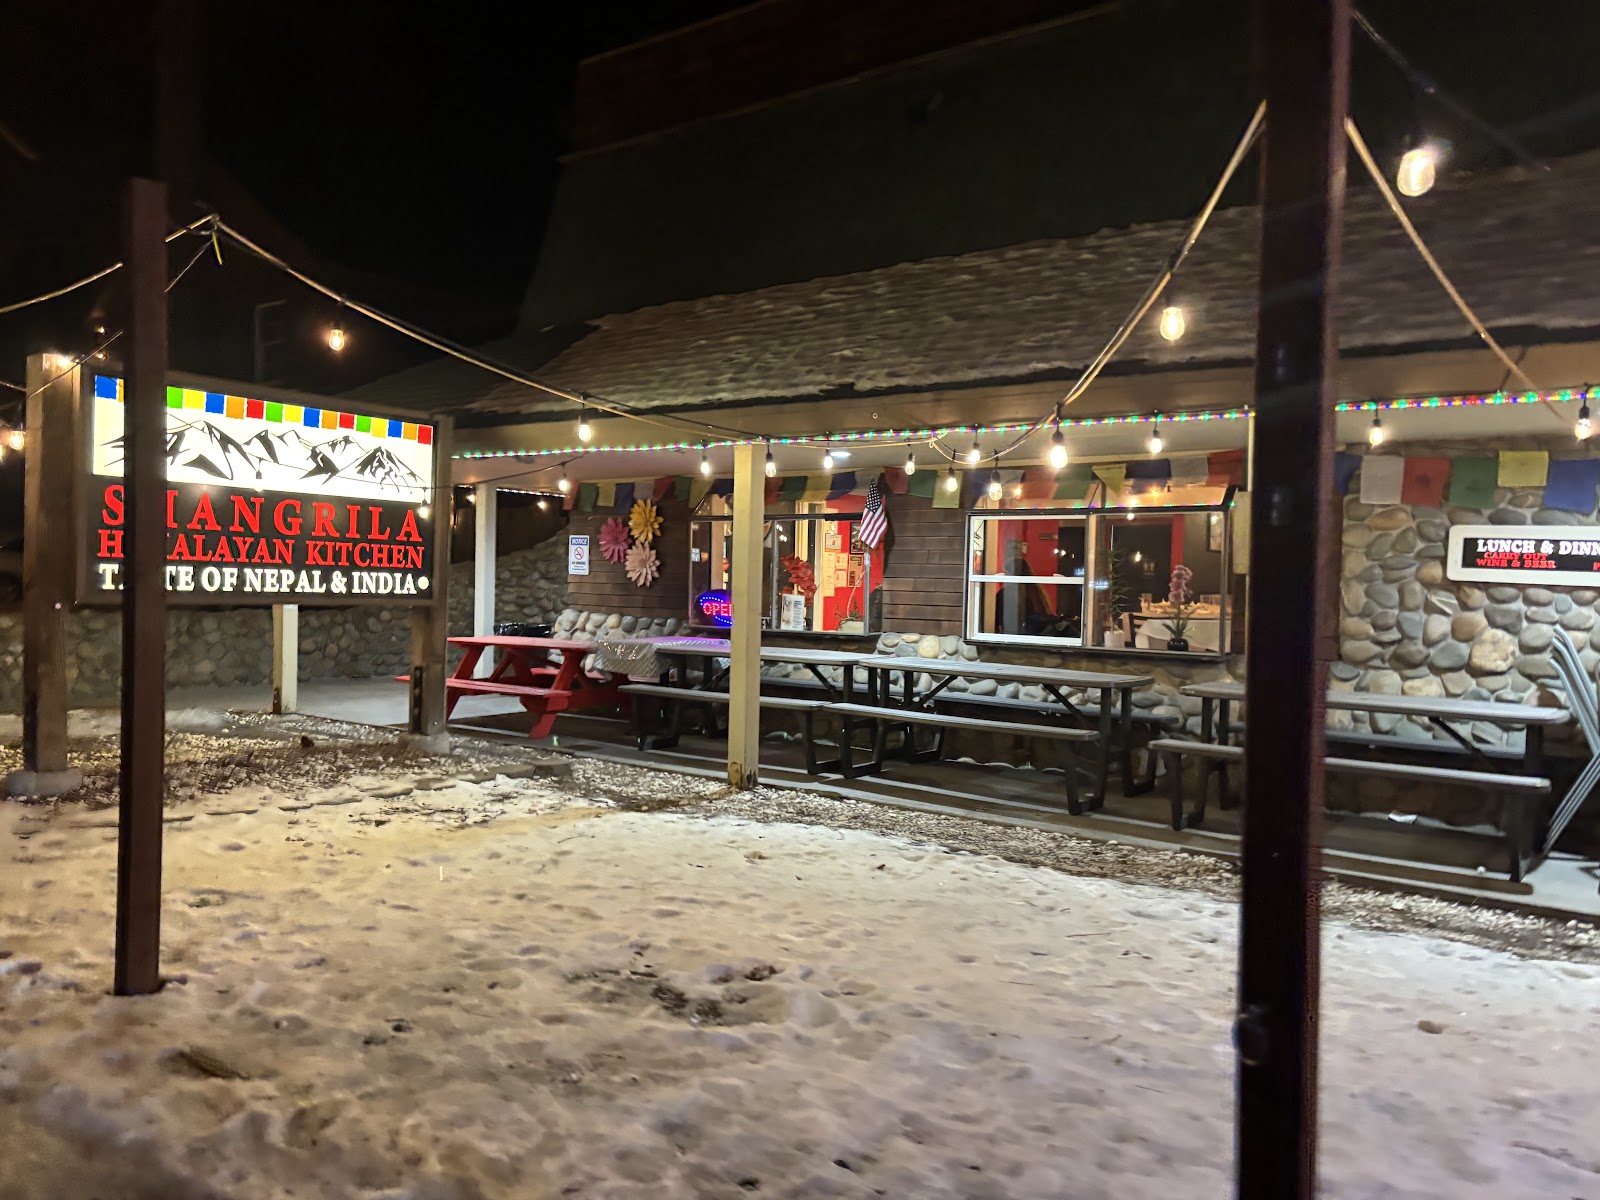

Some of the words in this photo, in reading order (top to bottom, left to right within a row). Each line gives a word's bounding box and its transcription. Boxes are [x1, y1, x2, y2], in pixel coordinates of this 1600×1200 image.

[97, 529, 295, 564] HALAYAN
[306, 540, 425, 569] KITCHEN
[1477, 539, 1536, 553] LUNCH
[1540, 540, 1554, 554] &
[1476, 558, 1508, 567] WINE
[1511, 560, 1521, 568] &
[1524, 560, 1556, 568] BEER
[1484, 552, 1521, 560] CARRY
[1523, 552, 1549, 561] OUT
[99, 564, 194, 591] TTE
[201, 566, 237, 592] OF
[243, 568, 327, 594] NEPAL
[330, 571, 347, 594] &
[352, 571, 418, 595] INDIA
[703, 602, 732, 617] OPE
